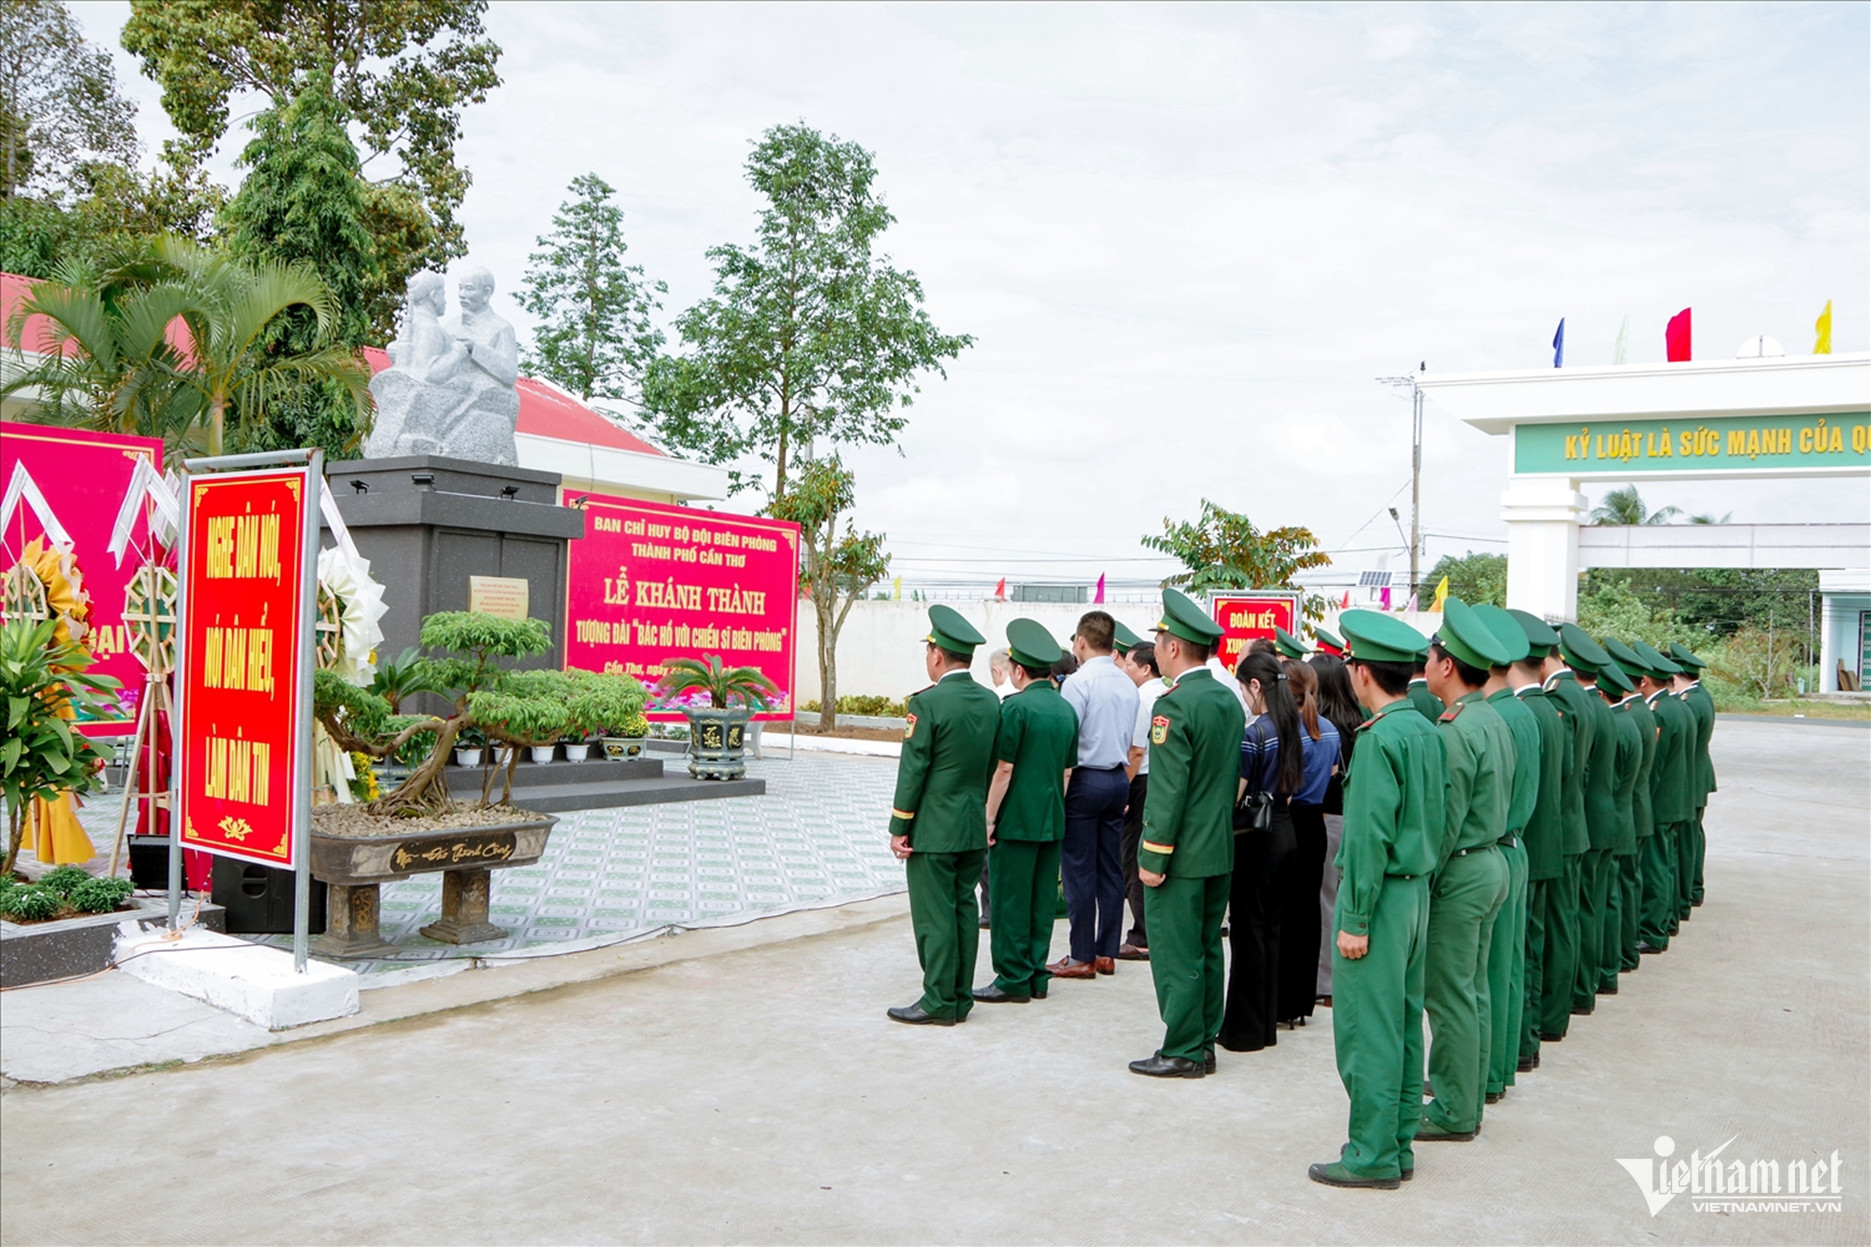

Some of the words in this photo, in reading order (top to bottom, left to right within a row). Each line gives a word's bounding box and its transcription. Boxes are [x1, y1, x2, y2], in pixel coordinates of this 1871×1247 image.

[1564, 427, 1591, 459] KỶ
[1596, 429, 1643, 463] LUẬT
[1647, 427, 1673, 457] LÀ
[1679, 426, 1721, 456] SỨC
[1727, 428, 1792, 460] MẠNH
[1799, 418, 1844, 453] CỦA
[206, 515, 235, 579] NGHE
[235, 501, 259, 578] DÂN
[259, 499, 281, 587] NÓI,
[594, 516, 621, 533] BAN
[624, 518, 645, 536] CHỈ
[648, 523, 671, 539] HUY
[673, 526, 690, 544] BỘ
[692, 528, 711, 546] ĐỘI
[714, 531, 739, 548] BIÊN
[741, 535, 777, 552] PHÒNG
[631, 542, 671, 560] THÀNH
[673, 546, 697, 563] PHỐ
[725, 553, 746, 568] THƠ
[604, 565, 629, 605] LỄ
[635, 576, 702, 610] KHÁNH
[706, 583, 766, 615] THÀNH
[576, 619, 611, 648] TƯỢNG
[612, 619, 630, 645] ĐÀI
[674, 624, 690, 648] VỚI
[692, 623, 719, 649] CHIẾN
[721, 626, 731, 649] SĨ
[732, 627, 752, 650] BIÊN
[1230, 609, 1256, 628] ĐOÀN
[204, 613, 224, 689] NÓI
[224, 614, 247, 690] DÂN
[247, 601, 275, 702] HIỂU,
[625, 662, 644, 676] Thơ,
[646, 663, 668, 677] ngày
[205, 723, 227, 799] LÀM
[228, 725, 250, 804] DÂN
[252, 741, 270, 807] TIN
